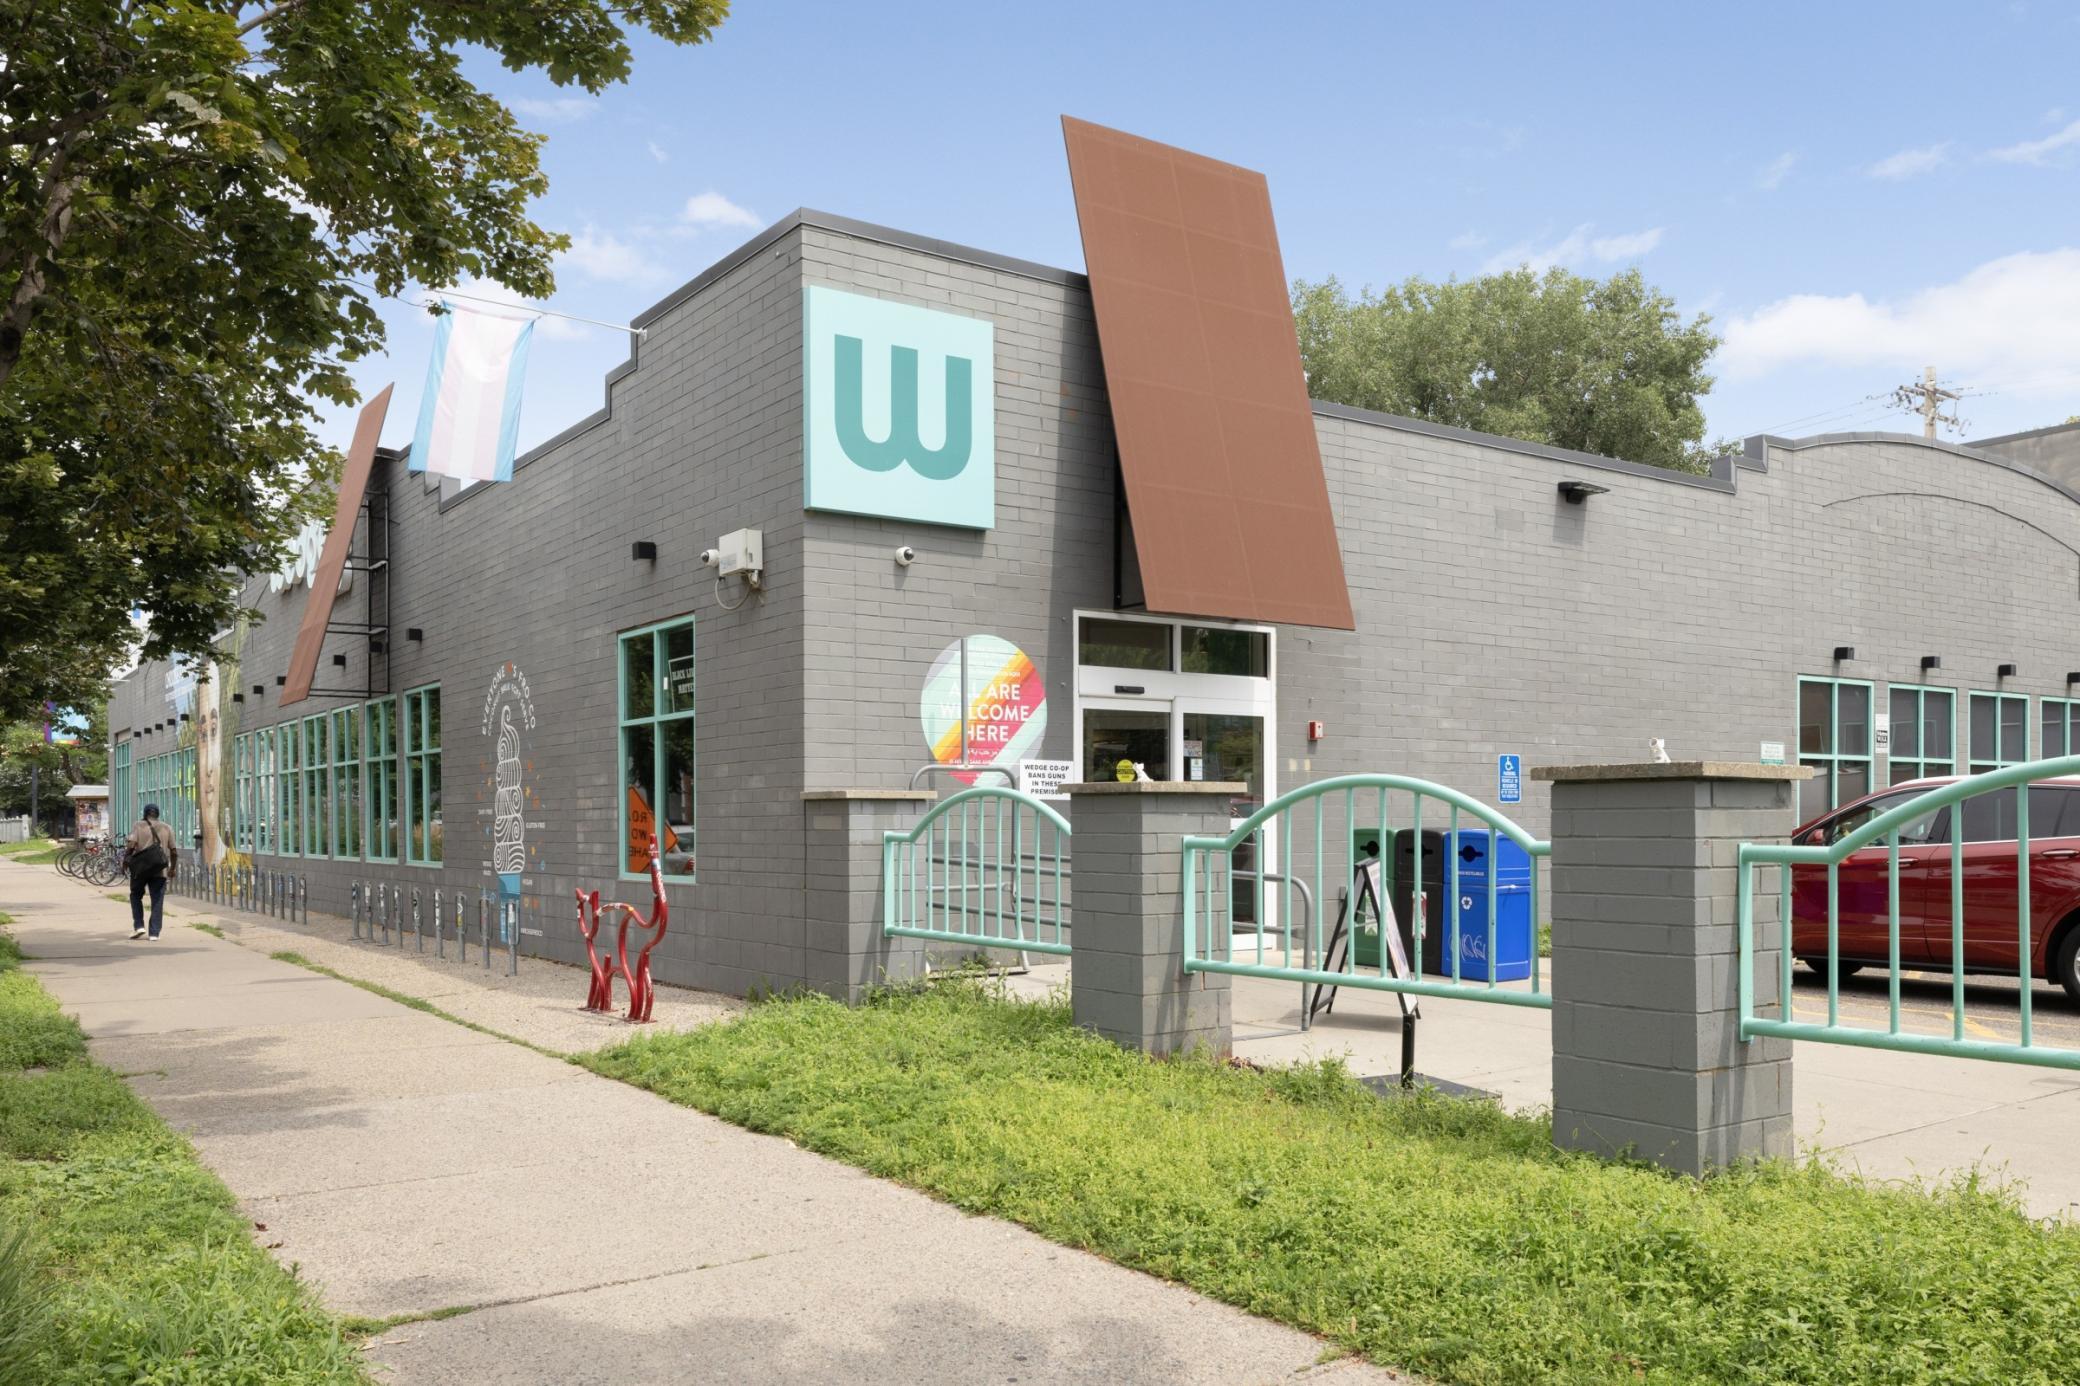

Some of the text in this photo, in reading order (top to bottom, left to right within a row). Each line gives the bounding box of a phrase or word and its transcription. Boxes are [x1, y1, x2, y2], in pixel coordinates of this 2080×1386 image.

[482, 665, 505, 735] EVERYONE
[948, 681, 1021, 701] AL ARE
[940, 702, 1030, 722] WLCOME
[967, 723, 1009, 742] HERE
